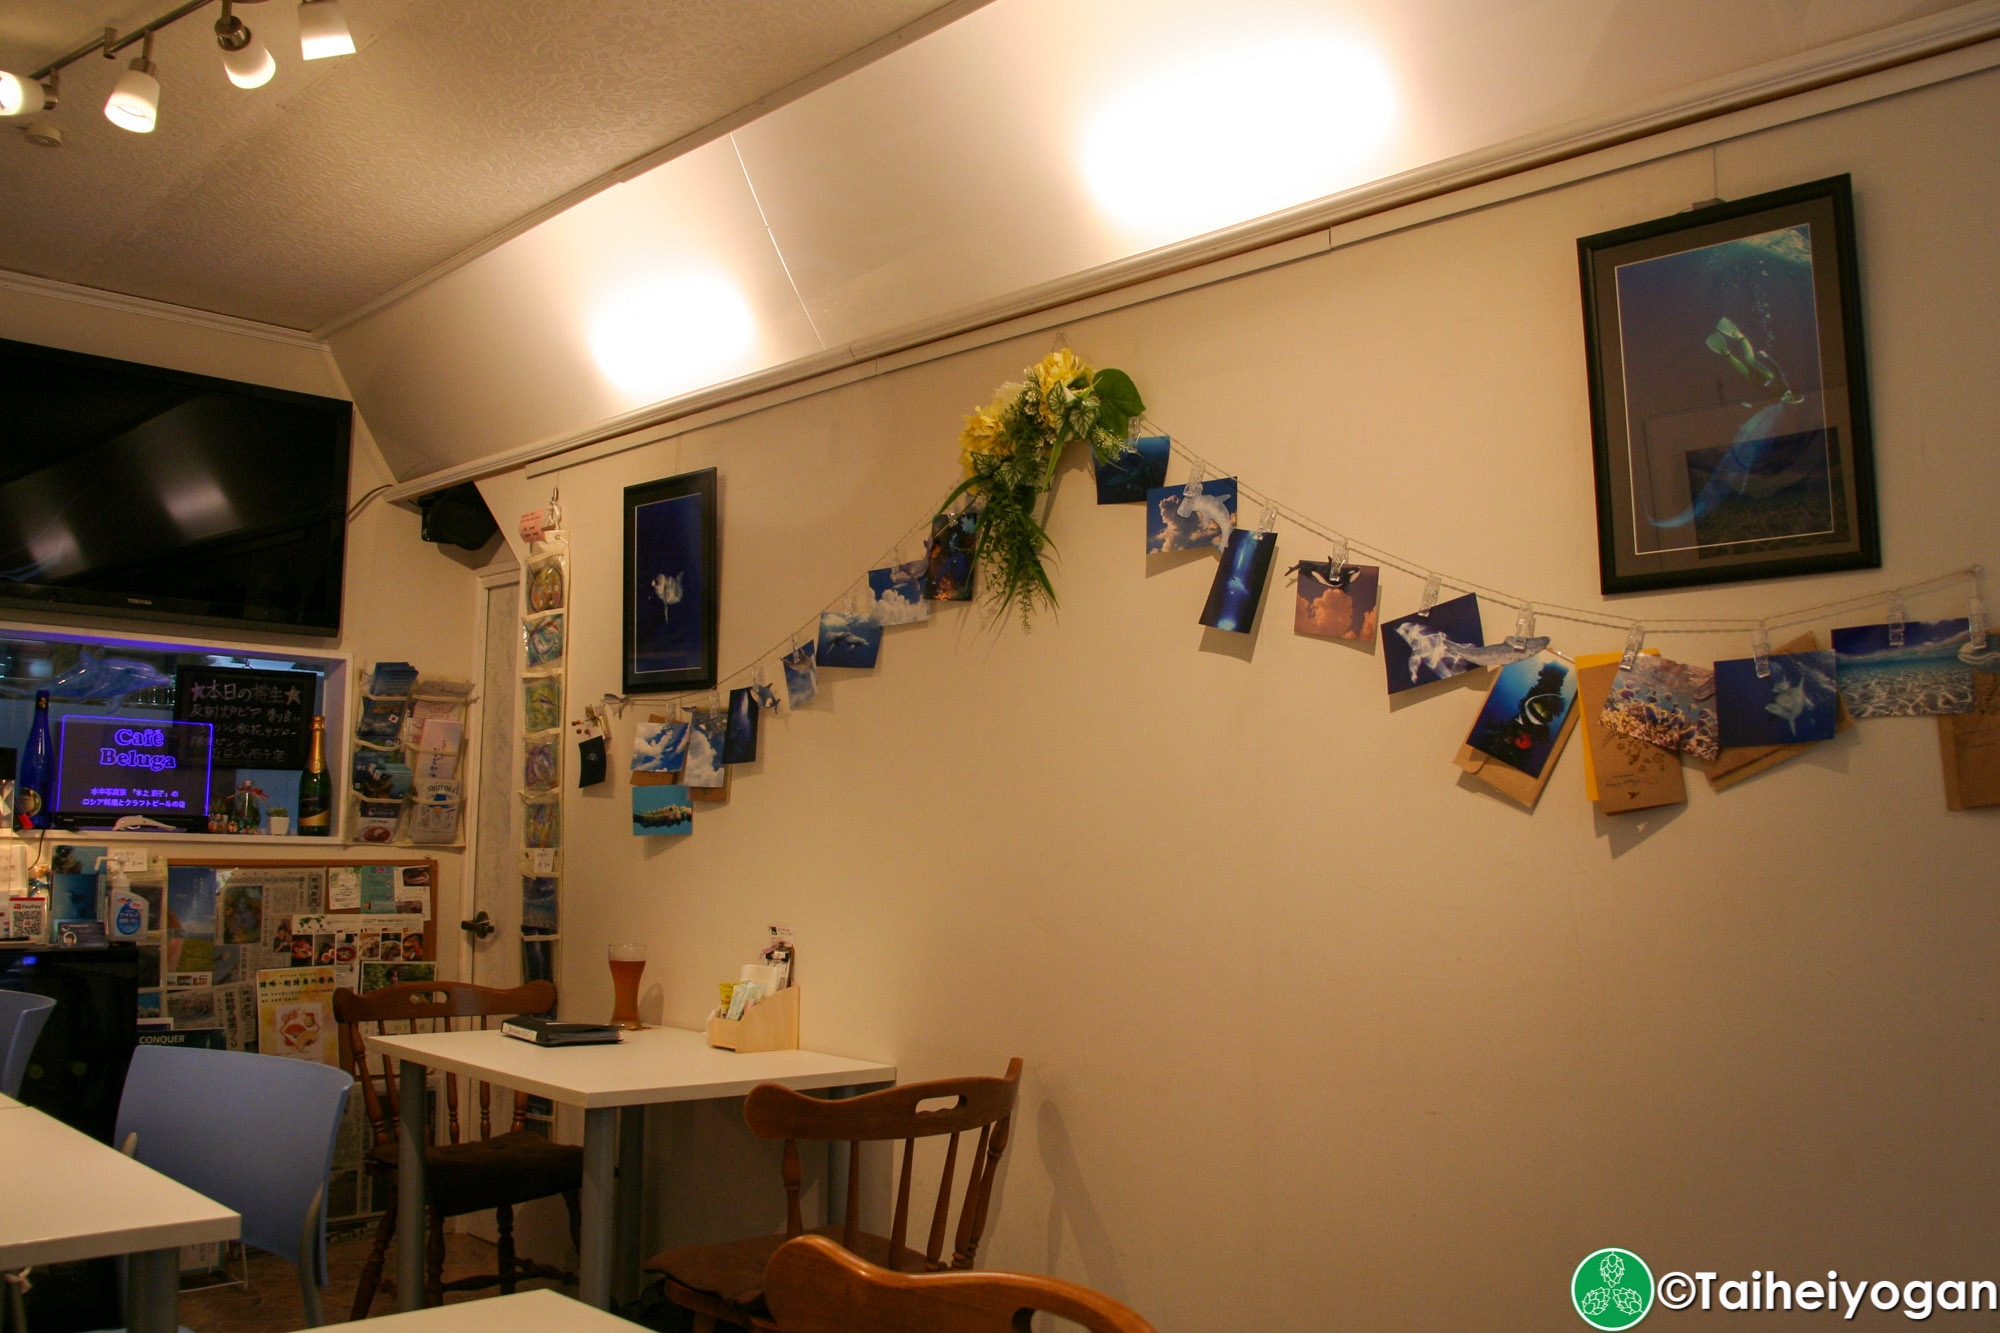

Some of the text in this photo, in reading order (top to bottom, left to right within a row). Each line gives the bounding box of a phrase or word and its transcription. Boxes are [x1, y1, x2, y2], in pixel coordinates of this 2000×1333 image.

[115, 729, 164, 746] Café
[100, 748, 176, 771] Beluga
[139, 1035, 185, 1044] CONQUER
